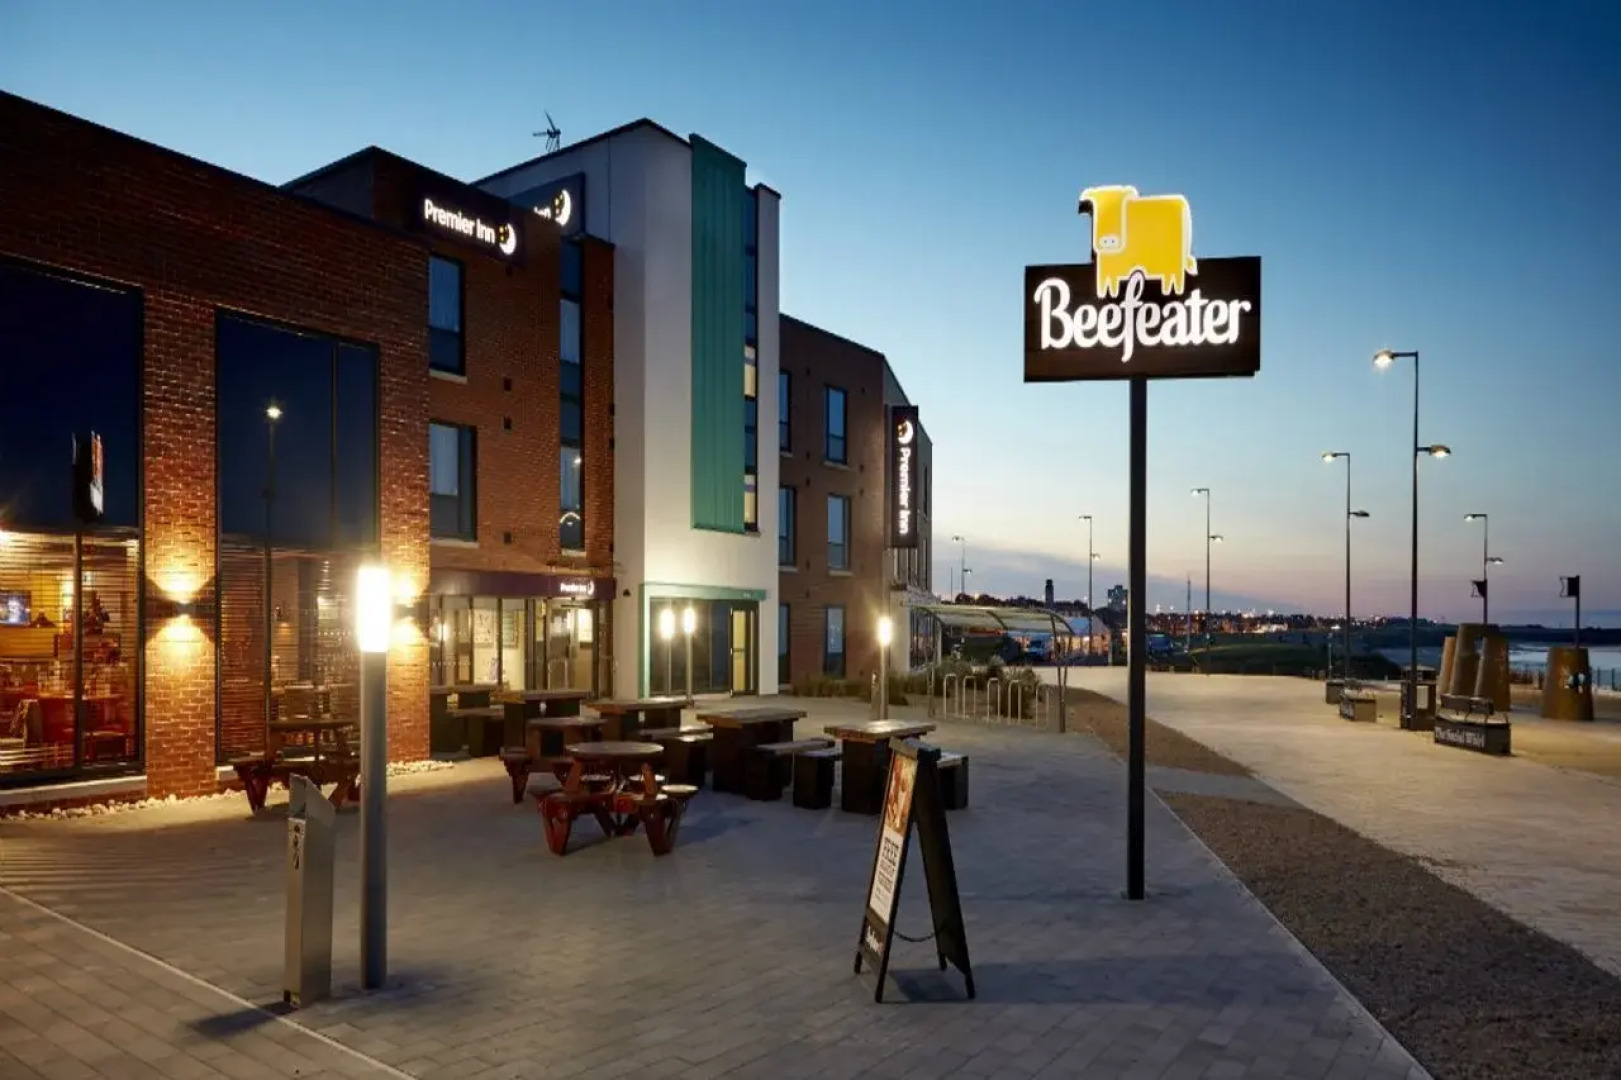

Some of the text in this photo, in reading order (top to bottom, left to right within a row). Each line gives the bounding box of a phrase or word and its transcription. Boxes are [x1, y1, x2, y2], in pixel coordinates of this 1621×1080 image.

[424, 198, 496, 244] Premier Inn
[1033, 269, 1252, 363] Beefeater
[899, 447, 911, 508] Premier
